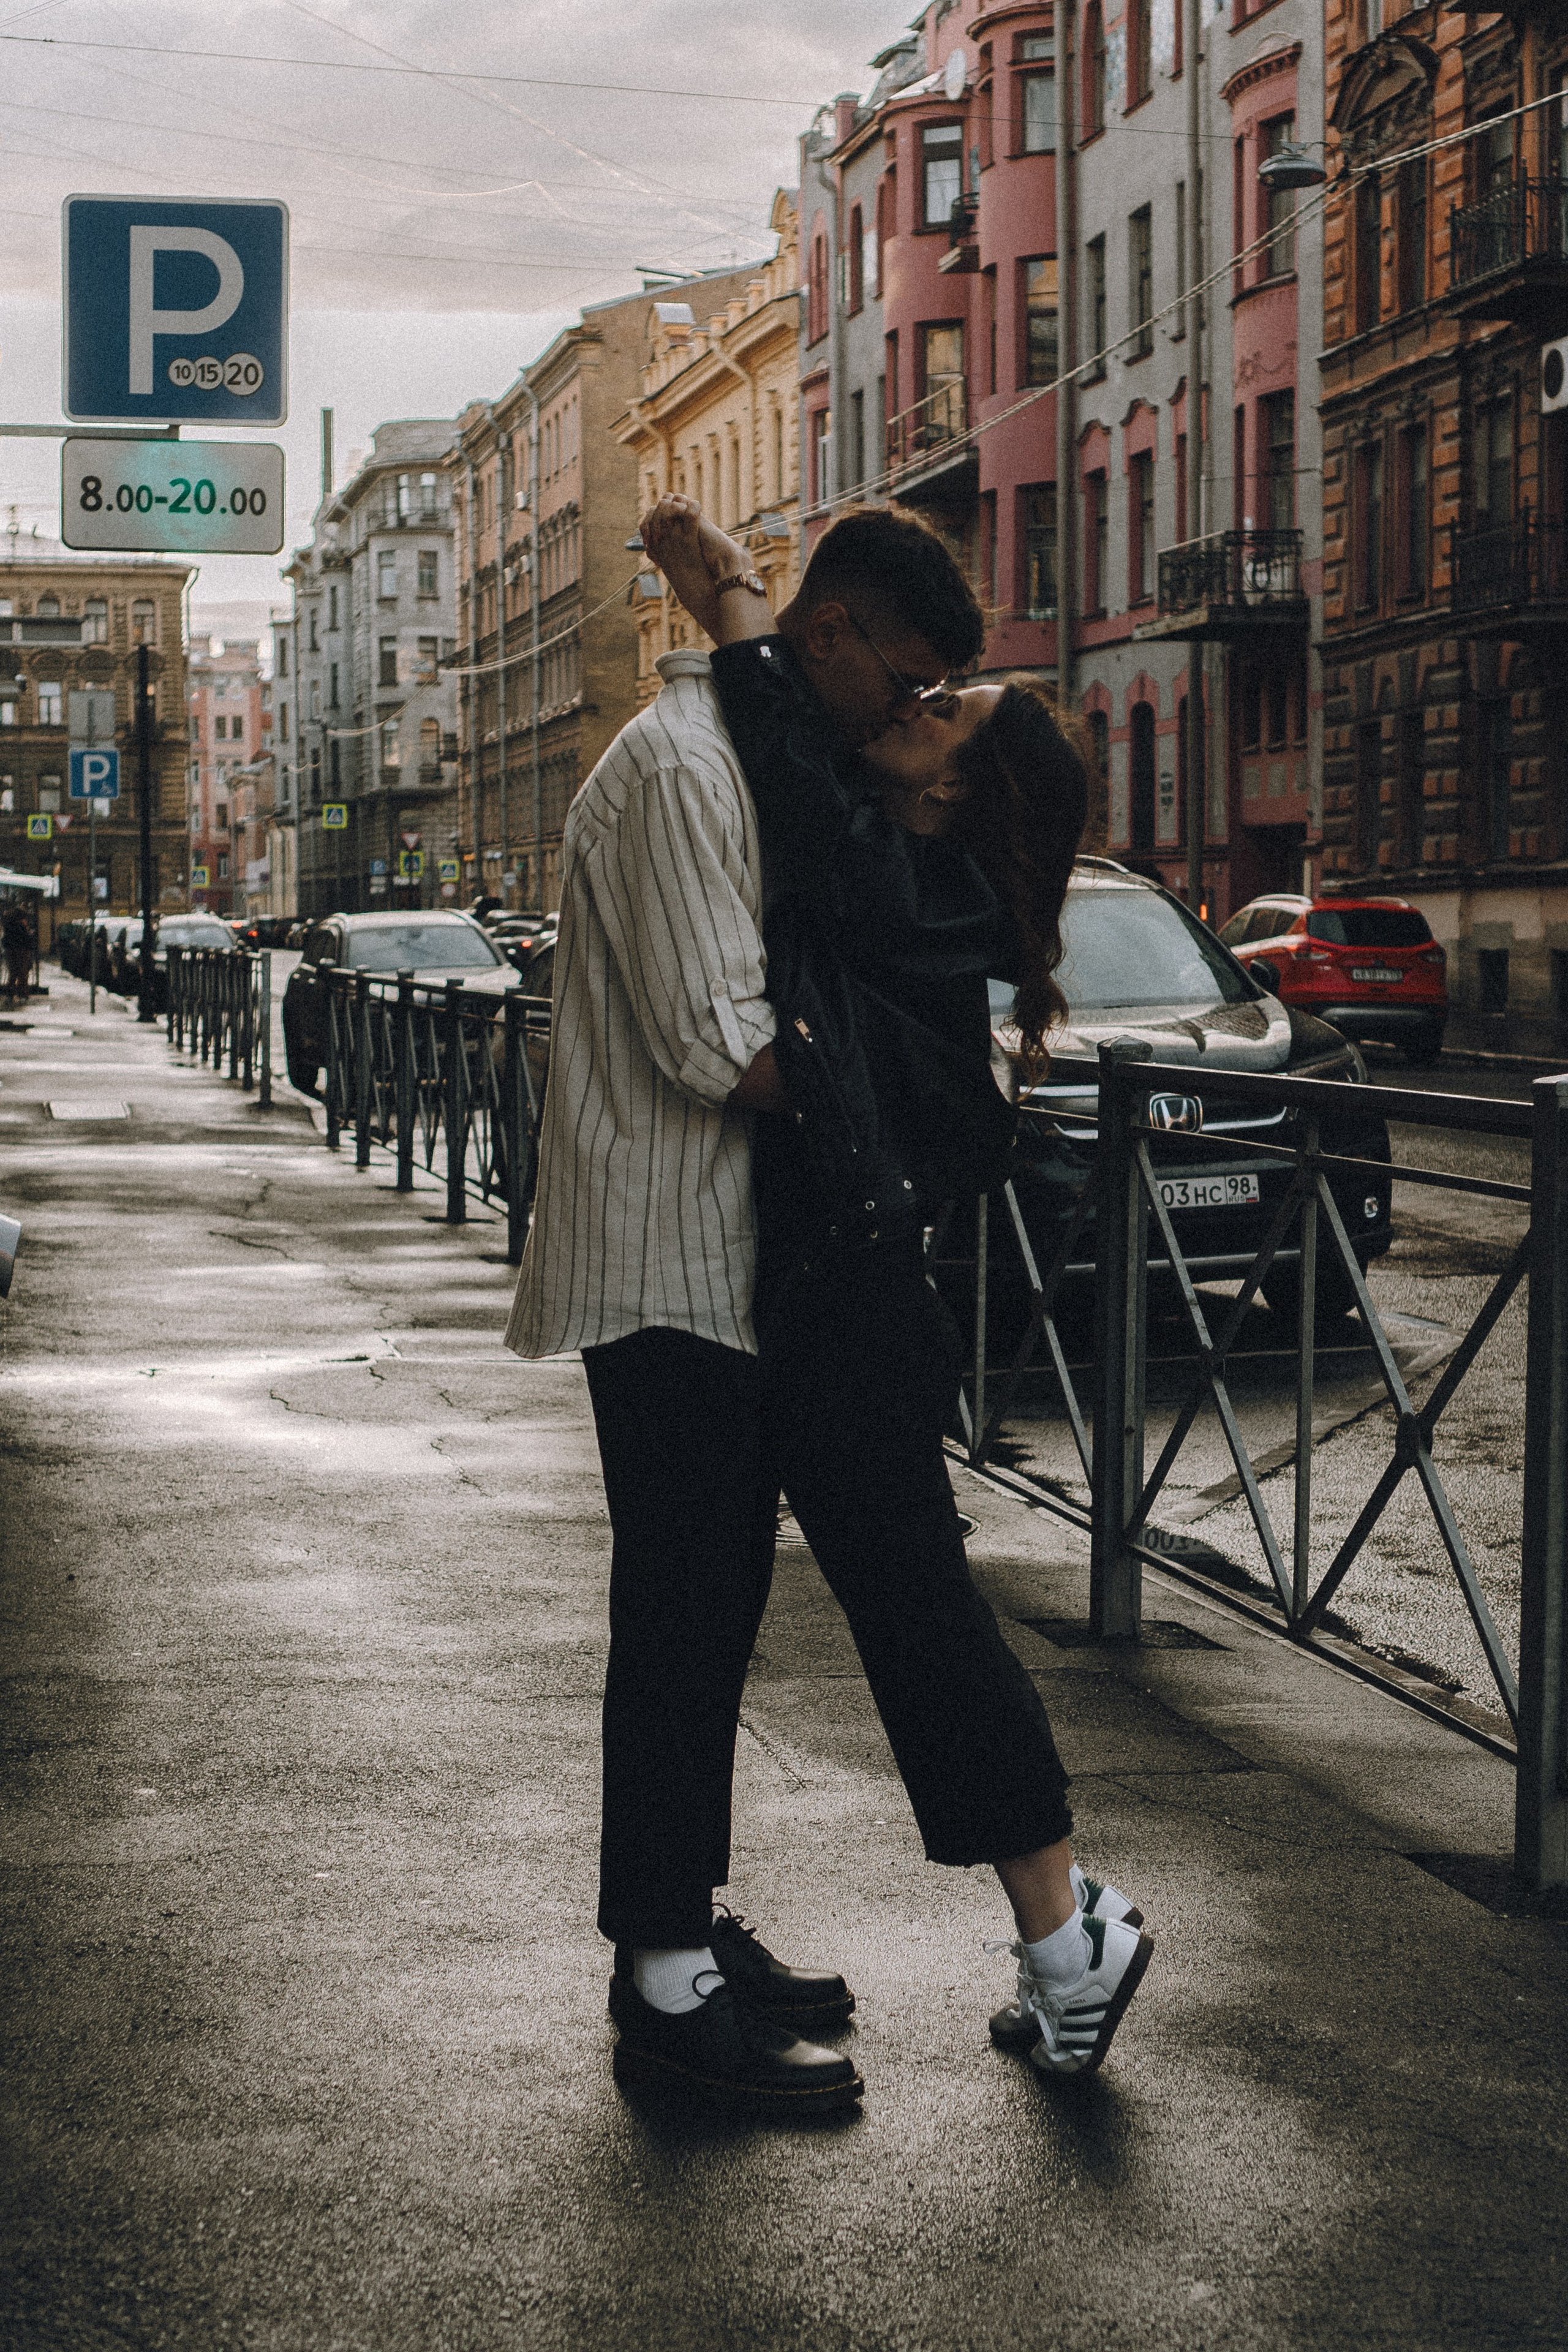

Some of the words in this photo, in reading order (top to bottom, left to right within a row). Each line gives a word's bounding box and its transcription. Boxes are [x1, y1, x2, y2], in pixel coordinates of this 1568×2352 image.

[129, 225, 244, 394] P
[175, 364, 190, 379] 10
[198, 364, 219, 382] 15
[227, 363, 258, 385] 20
[80, 475, 266, 516] 8.00-20.00
[83, 755, 110, 794] P
[1228, 1177, 1251, 1195] 98
